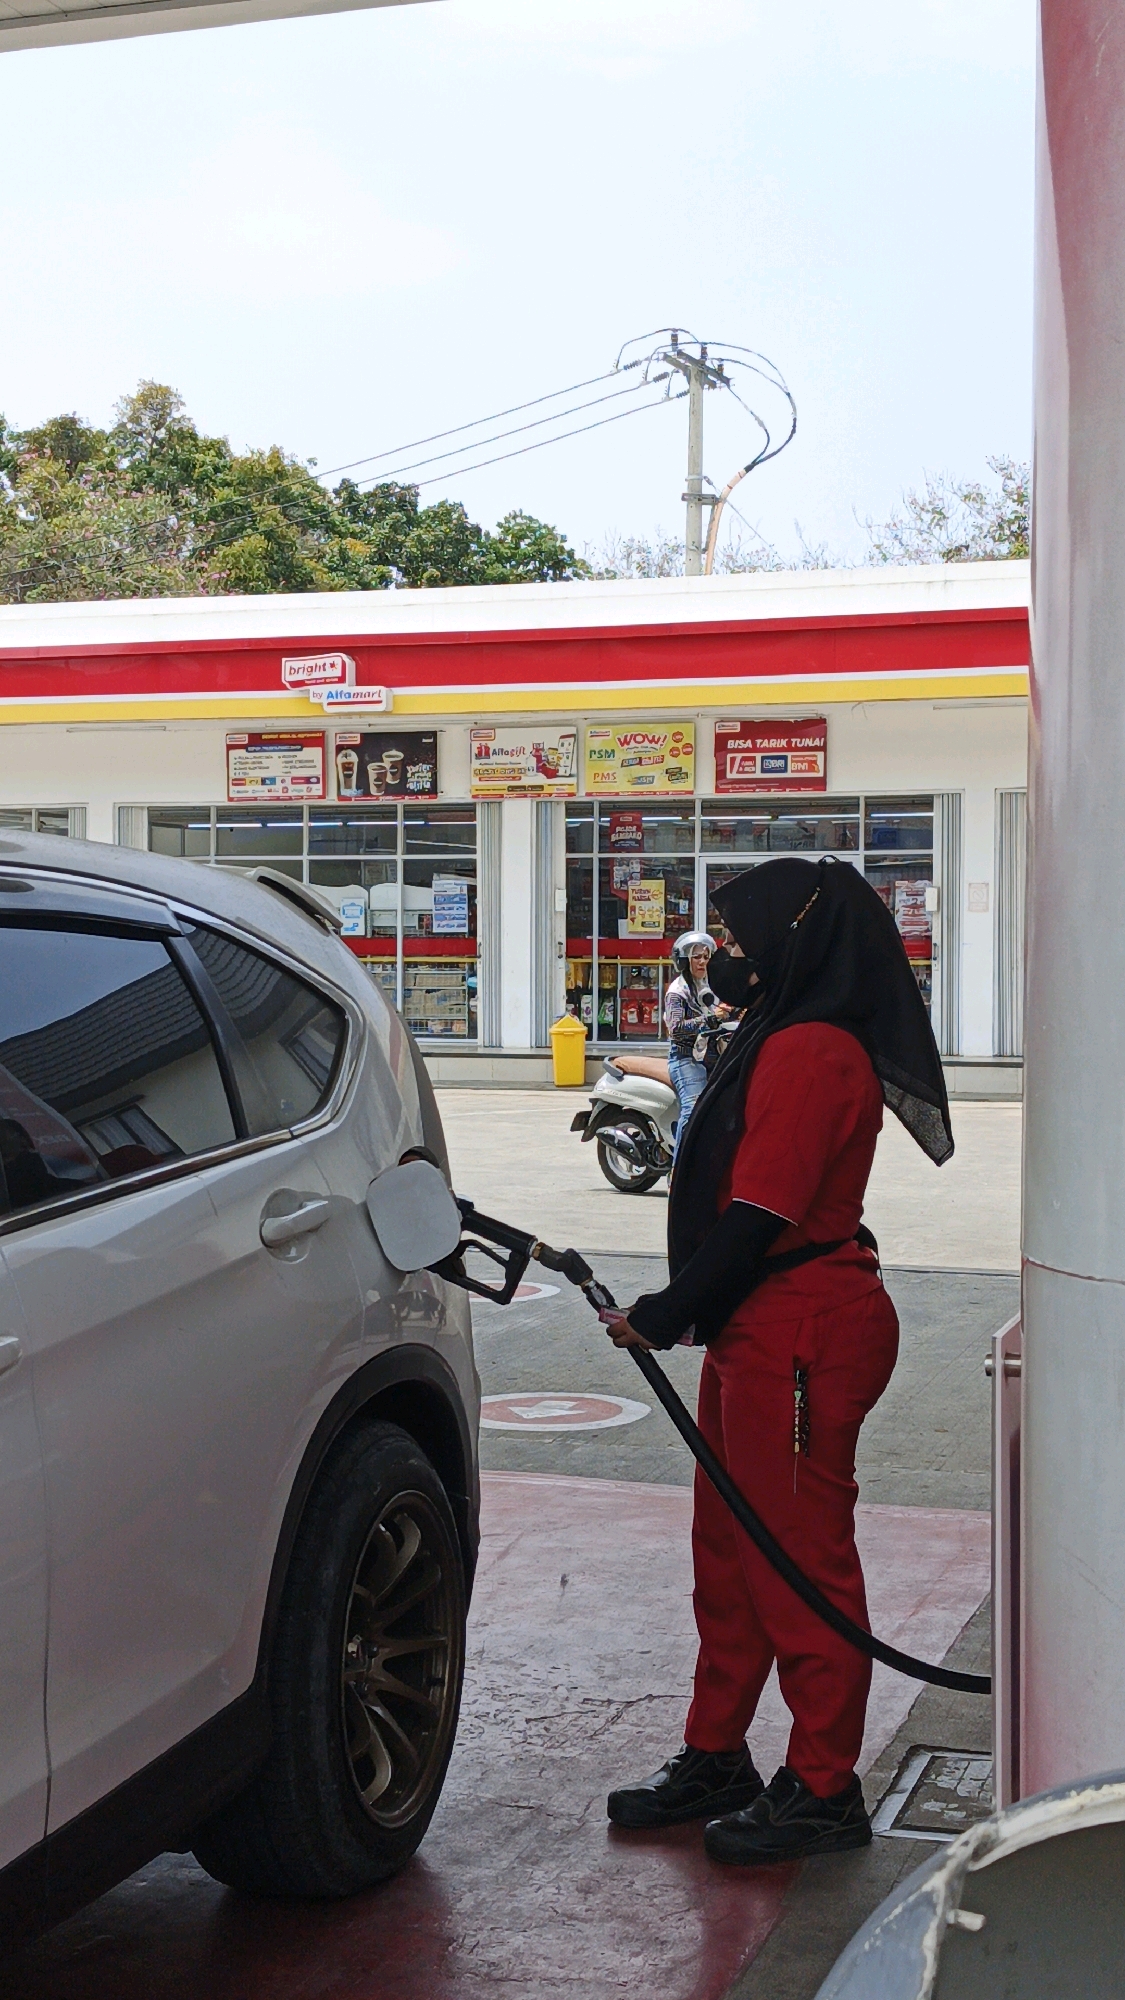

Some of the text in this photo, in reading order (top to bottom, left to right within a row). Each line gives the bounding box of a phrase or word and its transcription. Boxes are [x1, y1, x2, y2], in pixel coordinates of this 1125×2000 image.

[288, 662, 327, 676] bright
[312, 689, 382, 700] by Alfamart
[617, 733, 667, 747] WOW!
[727, 737, 825, 749] BISA TARIK TUNAI
[589, 748, 616, 759] PSM
[593, 771, 617, 781] PMS
